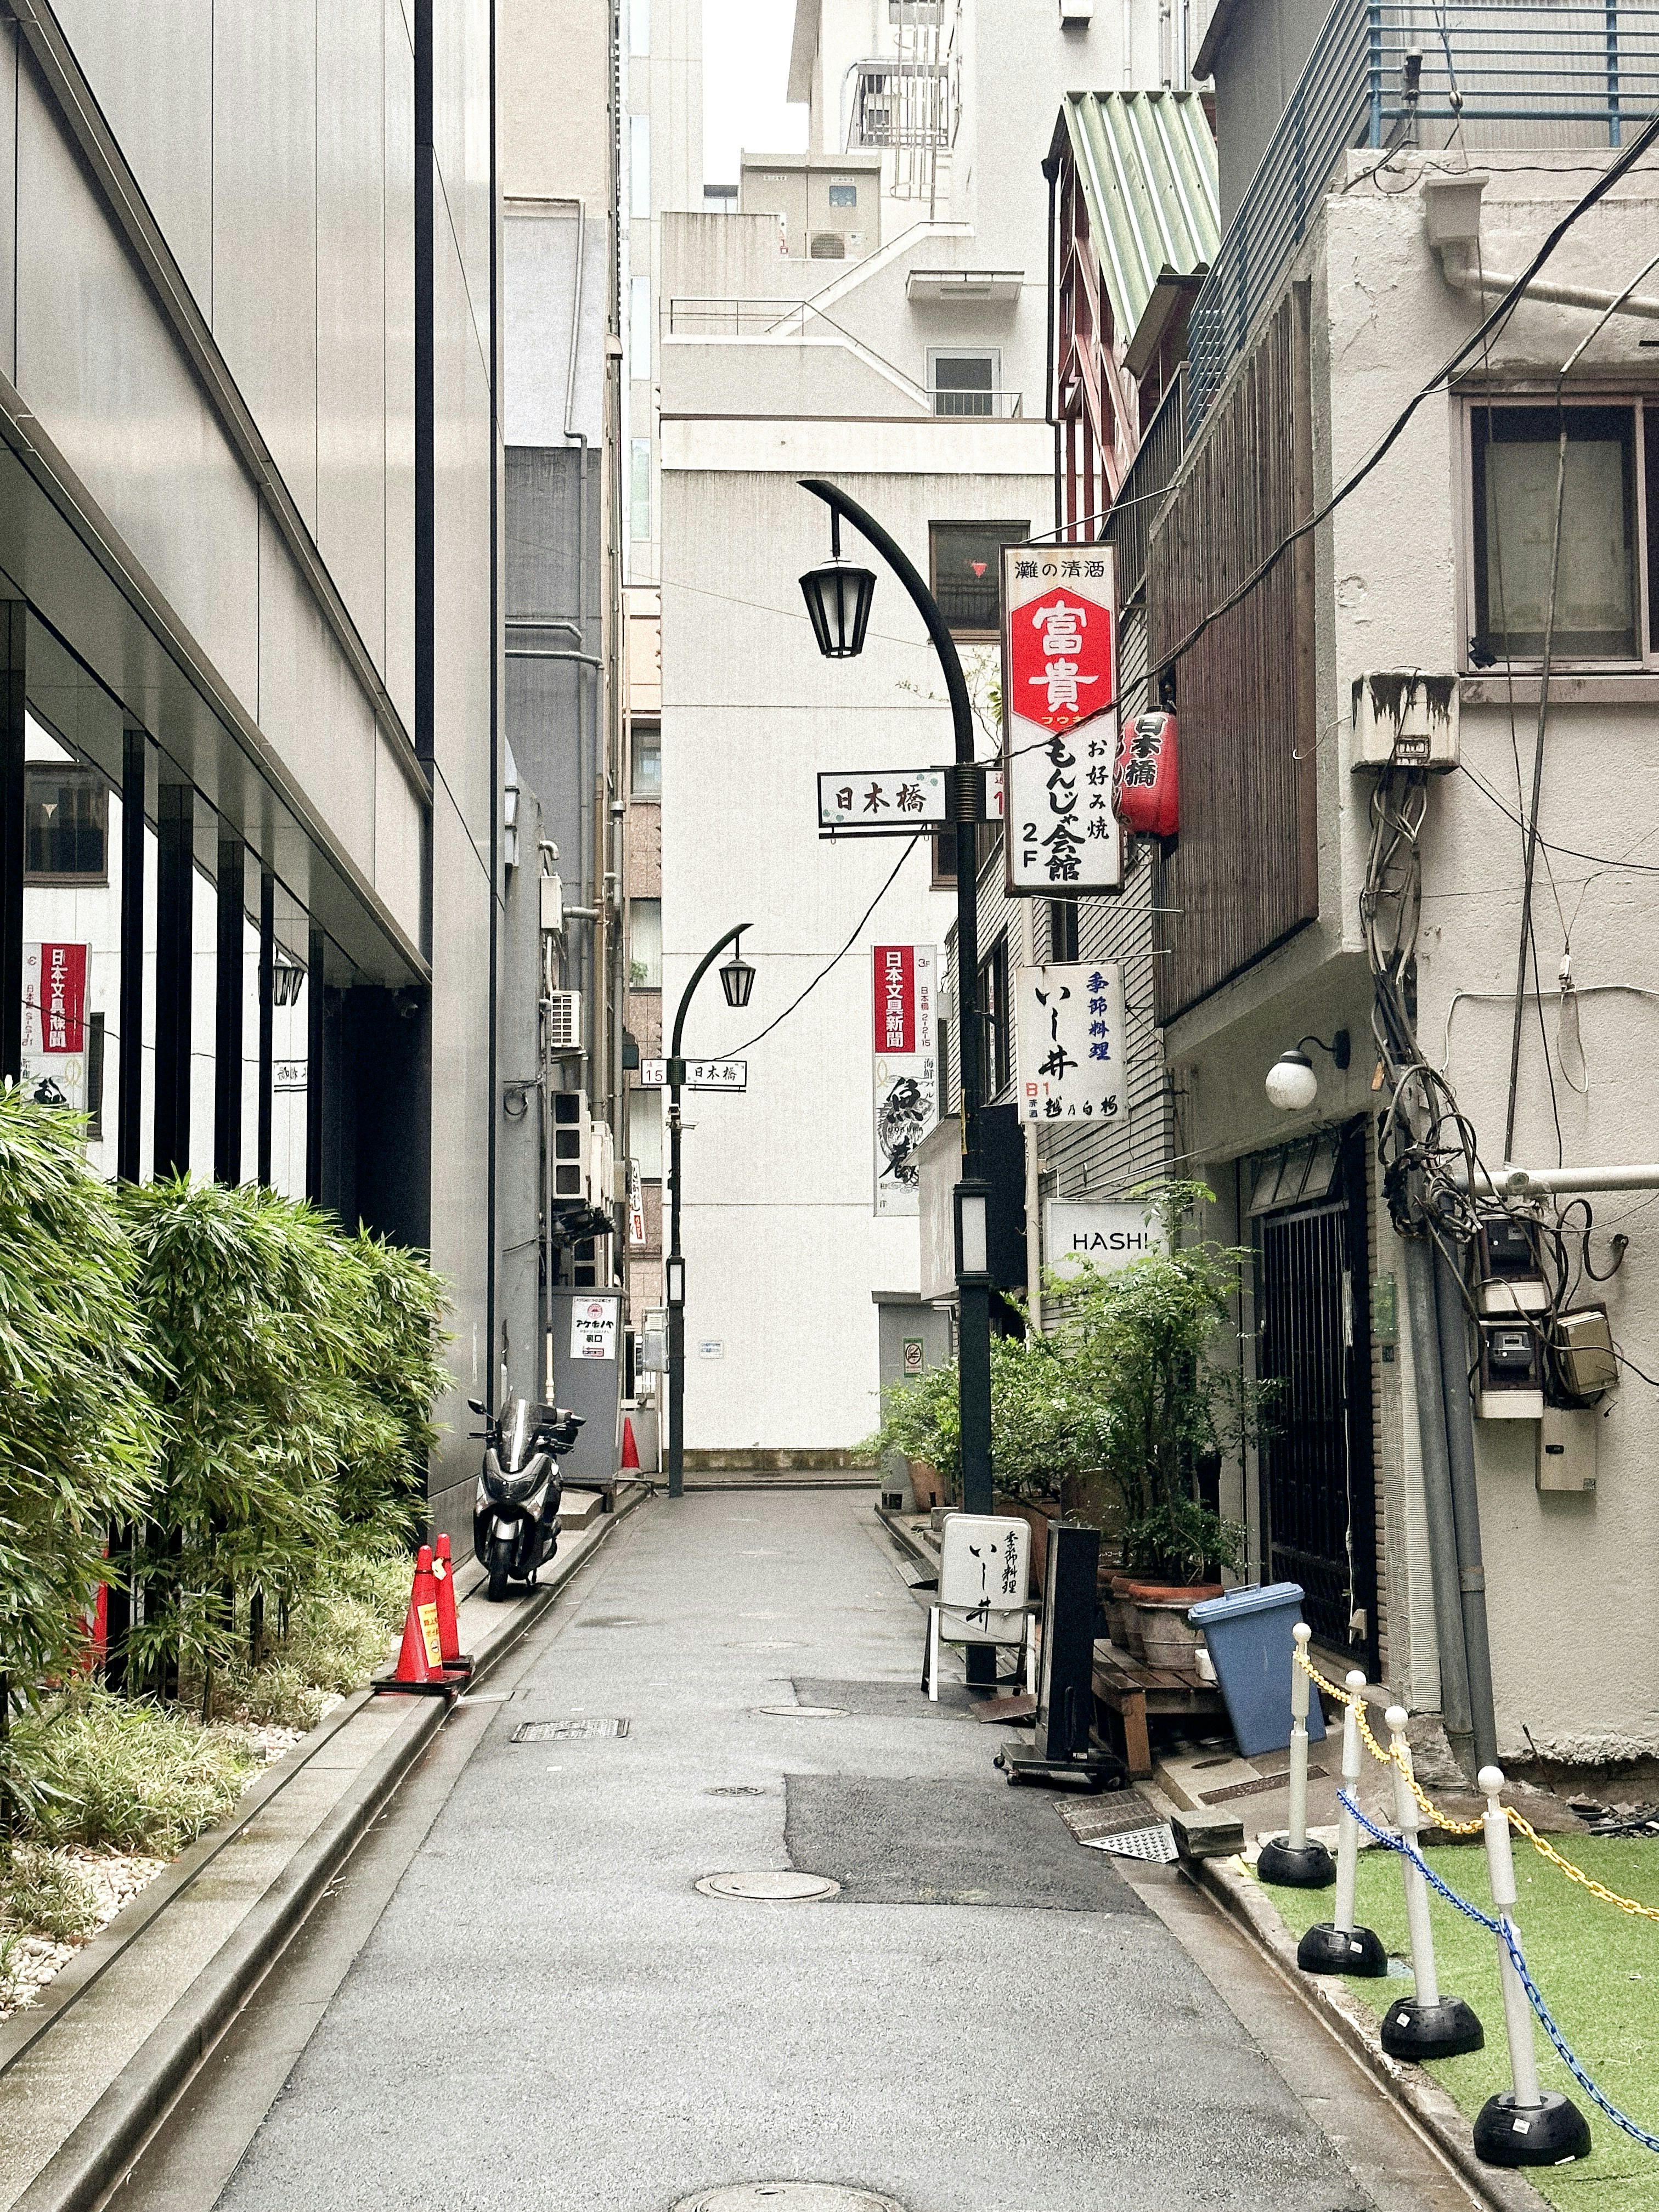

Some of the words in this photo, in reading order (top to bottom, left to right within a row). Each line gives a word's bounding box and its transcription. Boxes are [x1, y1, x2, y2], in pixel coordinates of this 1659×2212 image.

[1015, 560, 1104, 578] 灘の清酒
[1028, 600, 1099, 713] 富貴
[1125, 715, 1168, 788] 日本橋
[836, 782, 927, 814] 日本橋
[1040, 737, 1086, 881] もんじゃ会館
[1086, 740, 1109, 839] お好み焼
[884, 951, 904, 1048] 日本文具新聞
[1086, 971, 1111, 1061] 季節料理
[646, 1069, 663, 1082] 15
[695, 1064, 737, 1081] 日本橋
[1025, 1082, 1049, 1097] B1
[1001, 1531, 1018, 1594] 季節料理
